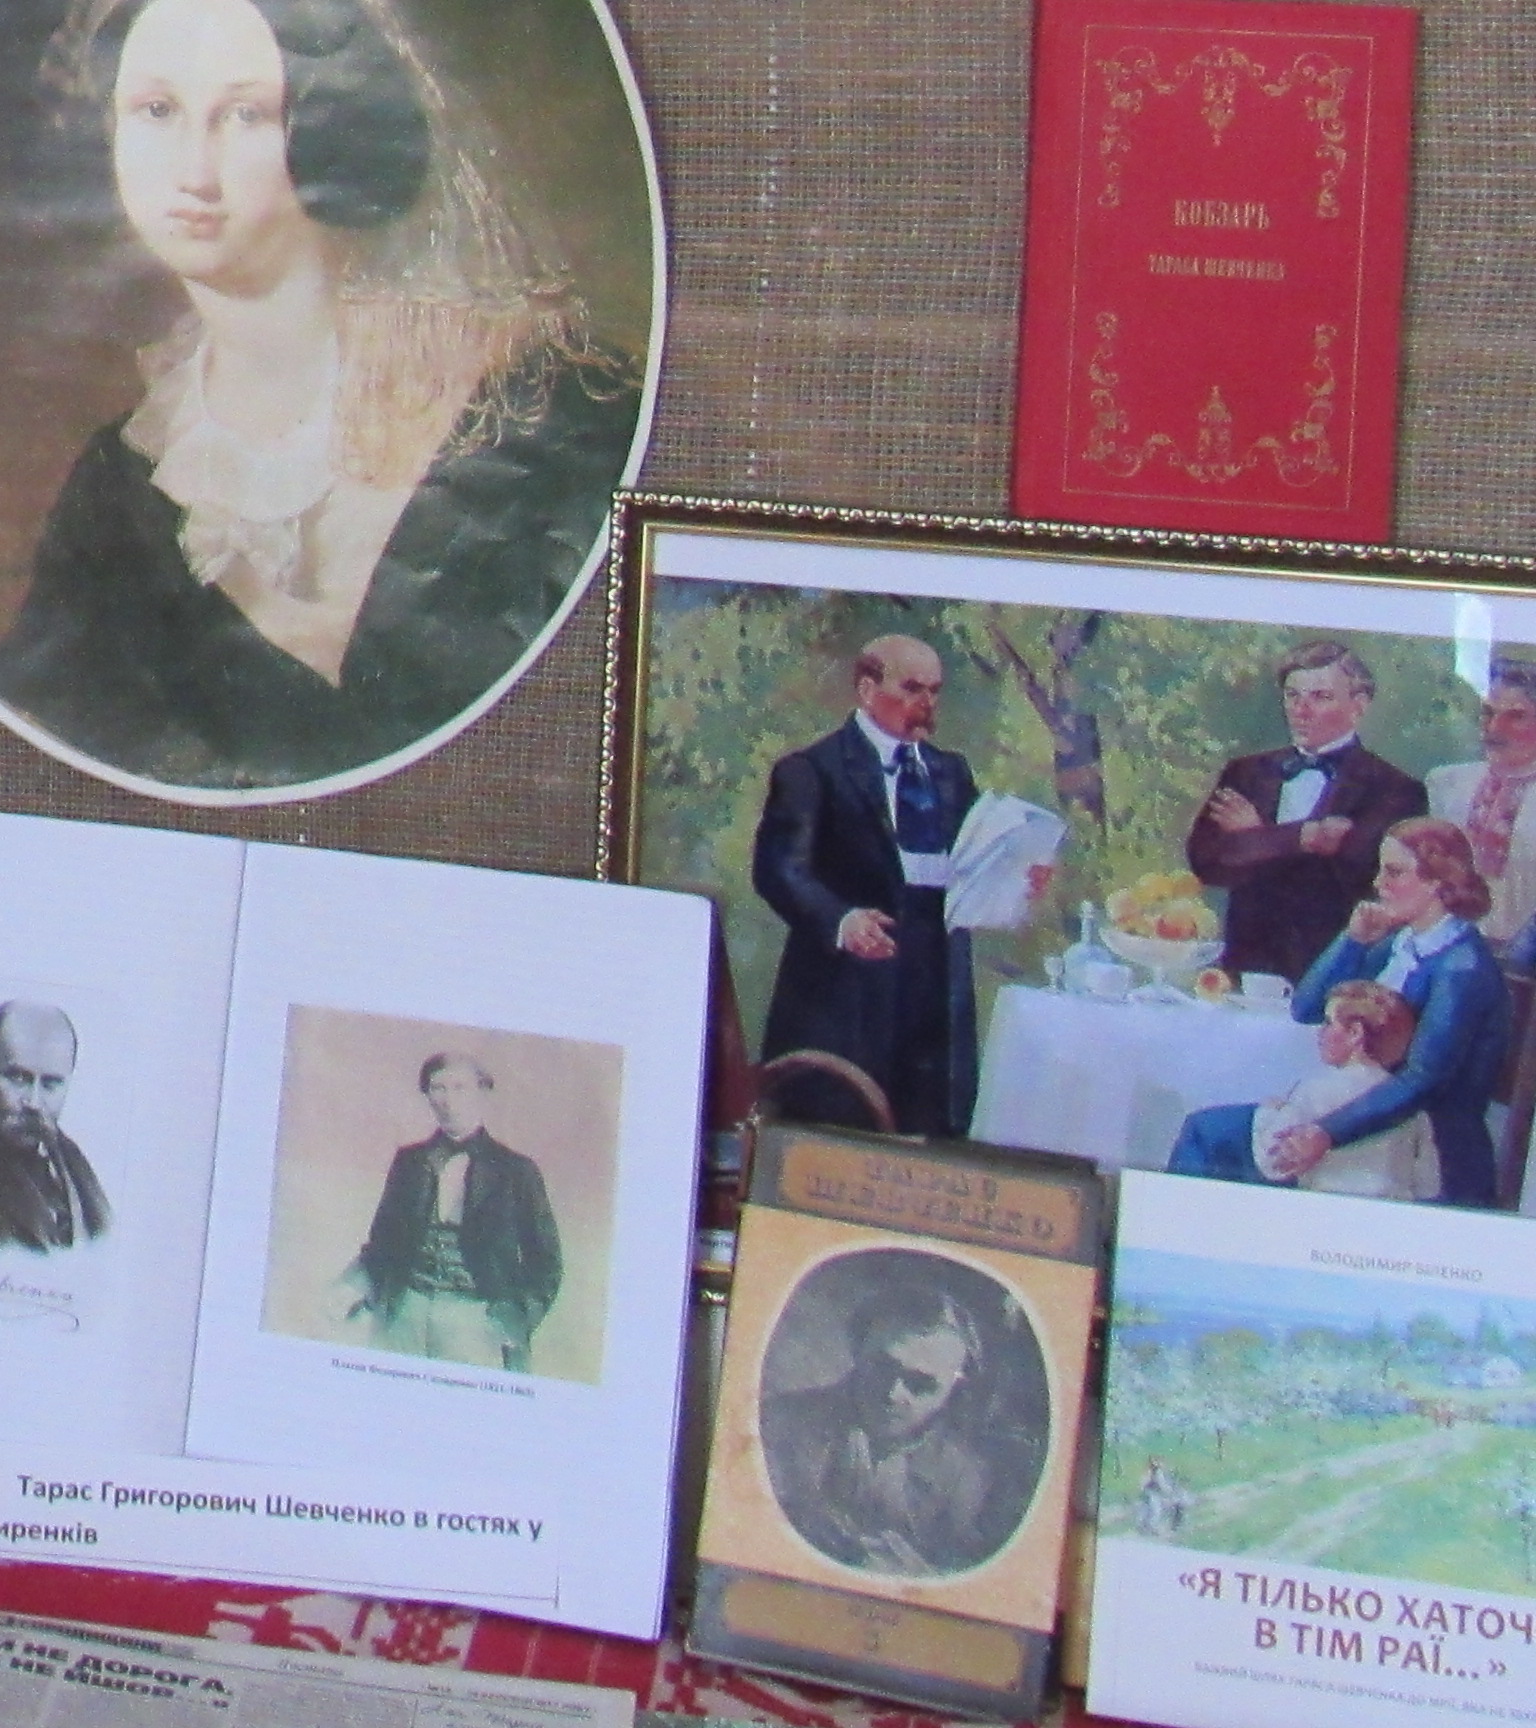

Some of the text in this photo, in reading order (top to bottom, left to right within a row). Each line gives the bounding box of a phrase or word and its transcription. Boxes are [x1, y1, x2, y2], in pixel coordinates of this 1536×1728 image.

[17, 1473, 543, 1542] Тарас Григорович Шевченко в гостях у
[1178, 1566, 1222, 1600] «Я
[1234, 1571, 1384, 1623] ТІЛЬКО
[23, 1641, 70, 1662] НЕ
[1254, 1617, 1278, 1650] В
[1290, 1621, 1363, 1664] ТІМ
